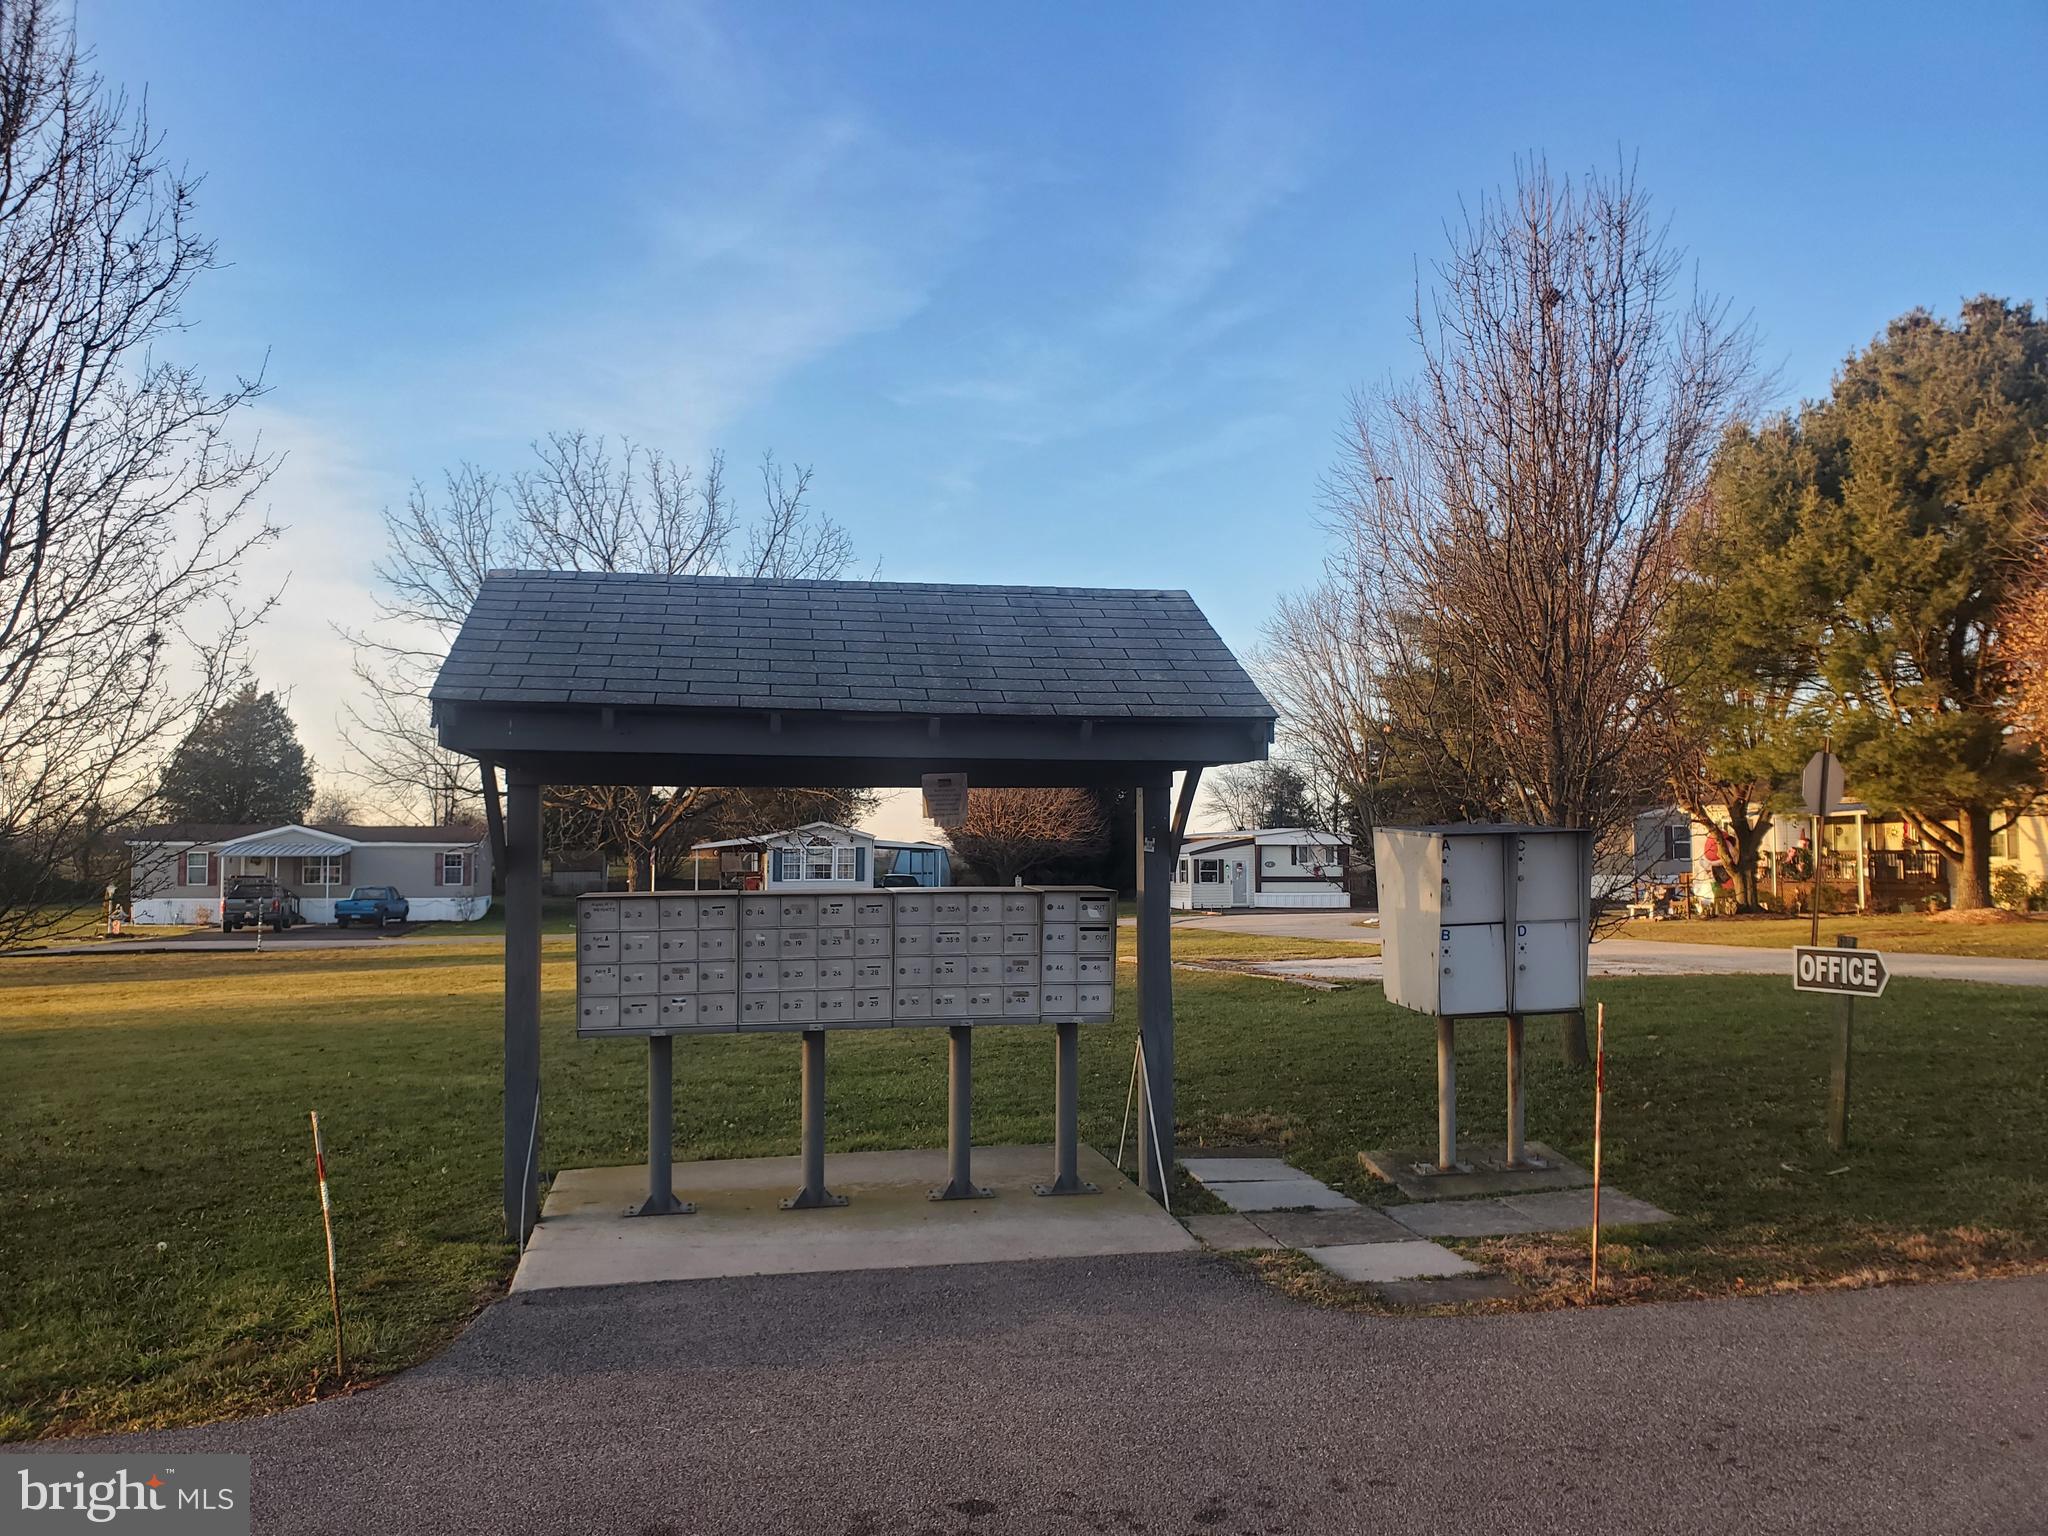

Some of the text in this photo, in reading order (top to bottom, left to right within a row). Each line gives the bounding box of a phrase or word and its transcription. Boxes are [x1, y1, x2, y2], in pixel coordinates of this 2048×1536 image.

[1442, 839, 1451, 852] A
[1517, 839, 1526, 852] C
[1441, 929, 1451, 941] B
[1517, 925, 1527, 937] D
[1800, 954, 1878, 987] OFFICE
